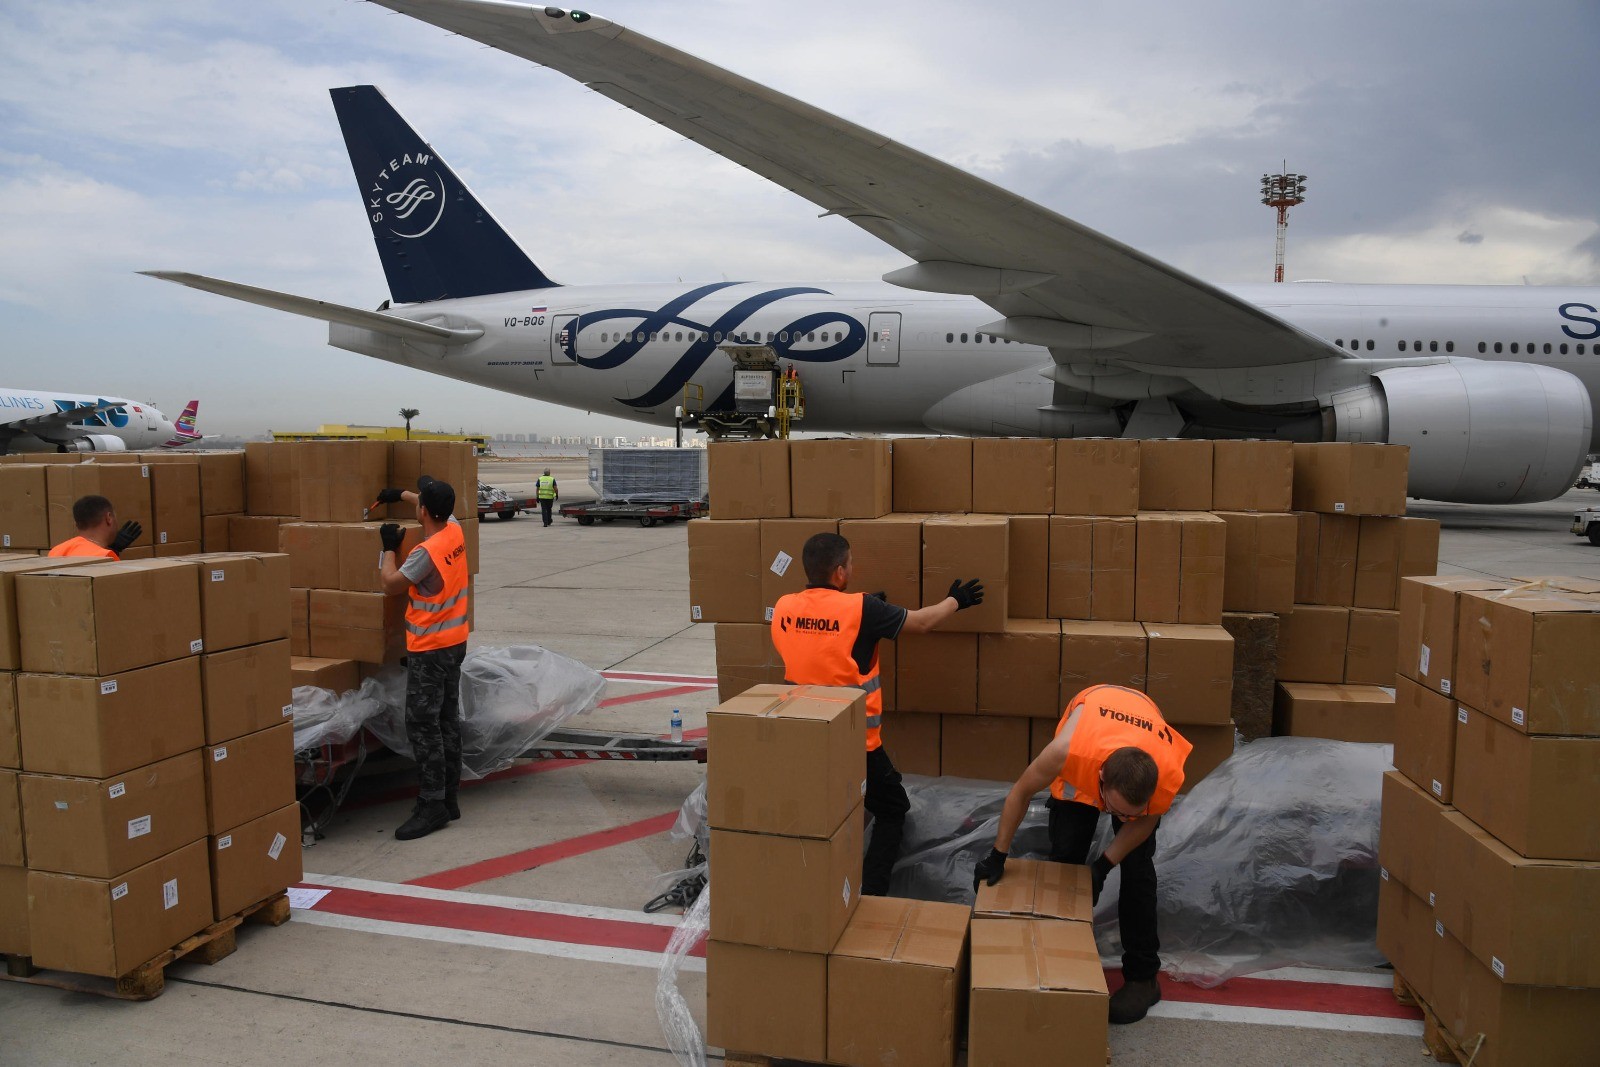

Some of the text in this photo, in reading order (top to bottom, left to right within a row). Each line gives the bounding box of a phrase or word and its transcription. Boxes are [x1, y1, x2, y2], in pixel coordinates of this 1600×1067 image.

[371, 153, 429, 223] SKYTEAM
[504, 316, 545, 327] VQ-BQG
[795, 616, 840, 632] MEHOLA
[1099, 706, 1153, 732] MEHOLA
